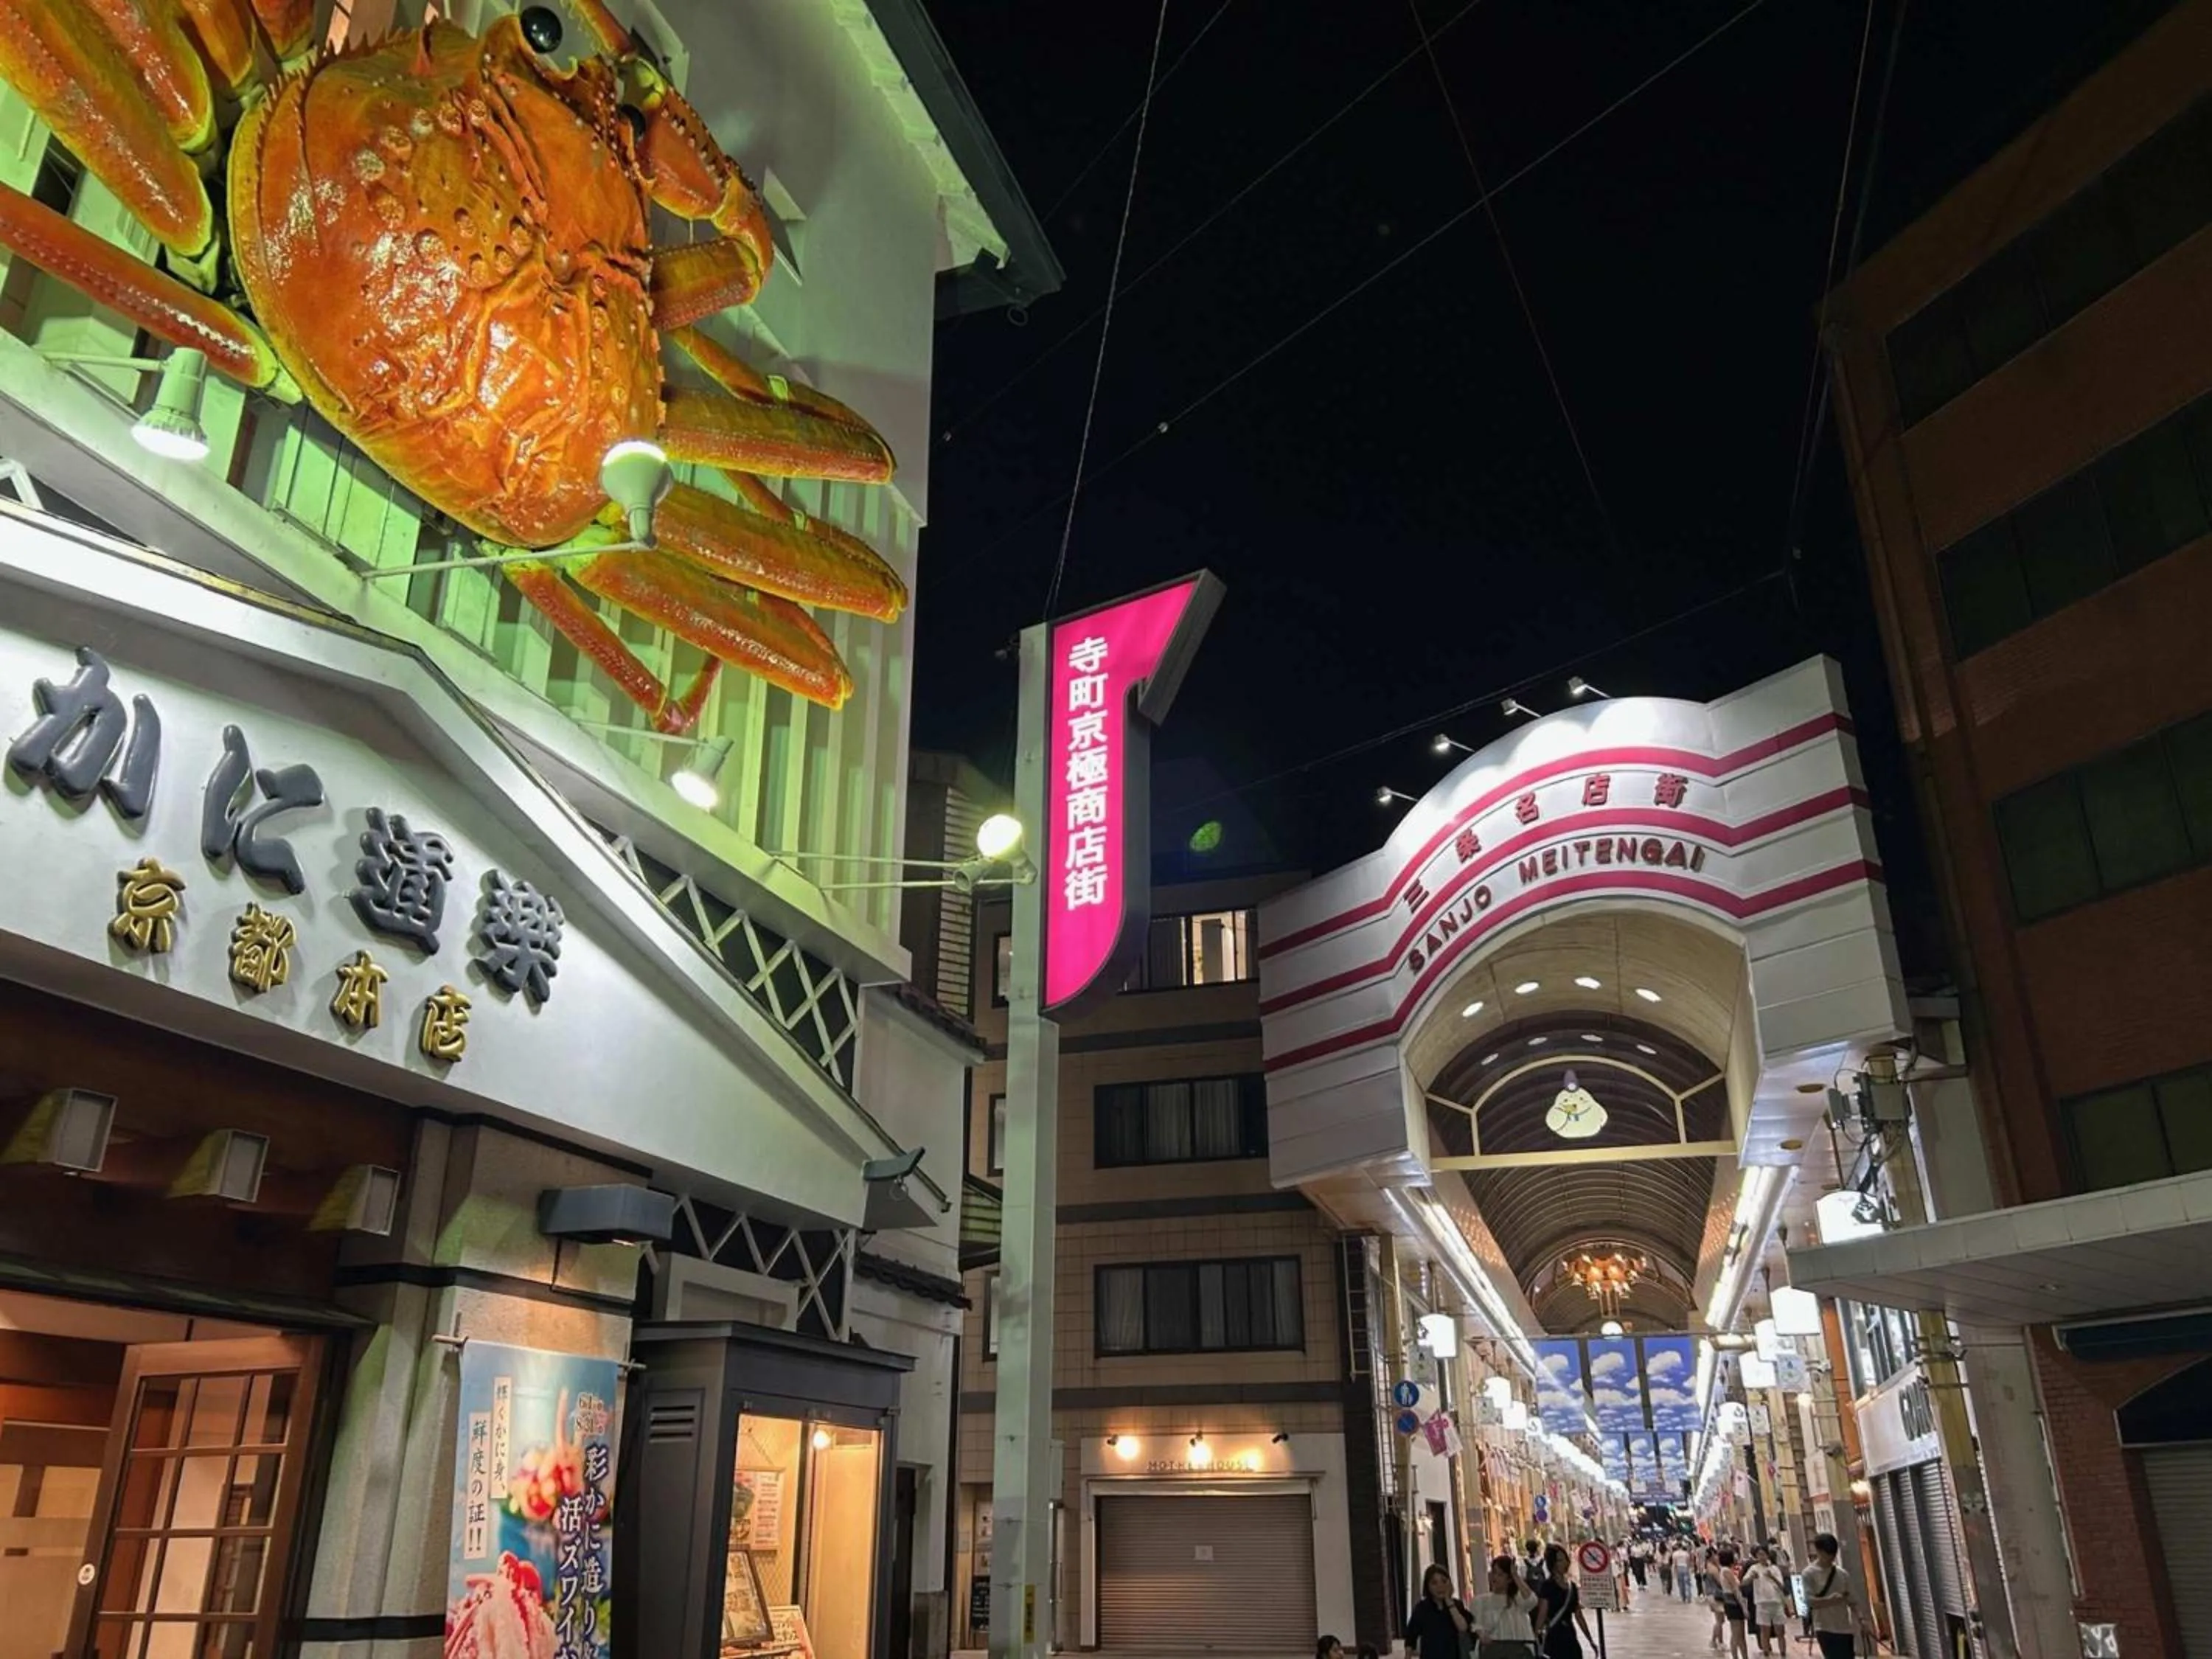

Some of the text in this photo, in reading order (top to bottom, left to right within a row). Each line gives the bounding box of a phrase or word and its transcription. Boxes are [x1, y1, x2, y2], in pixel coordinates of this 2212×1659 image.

[4, 645, 563, 1003] かに道楽
[1064, 637, 1107, 911] 寺町京極商店街
[1403, 773, 1688, 914] 三条名店街
[108, 857, 473, 1062] 京都本店
[1409, 837, 1705, 975] SANJO MEITENGAI
